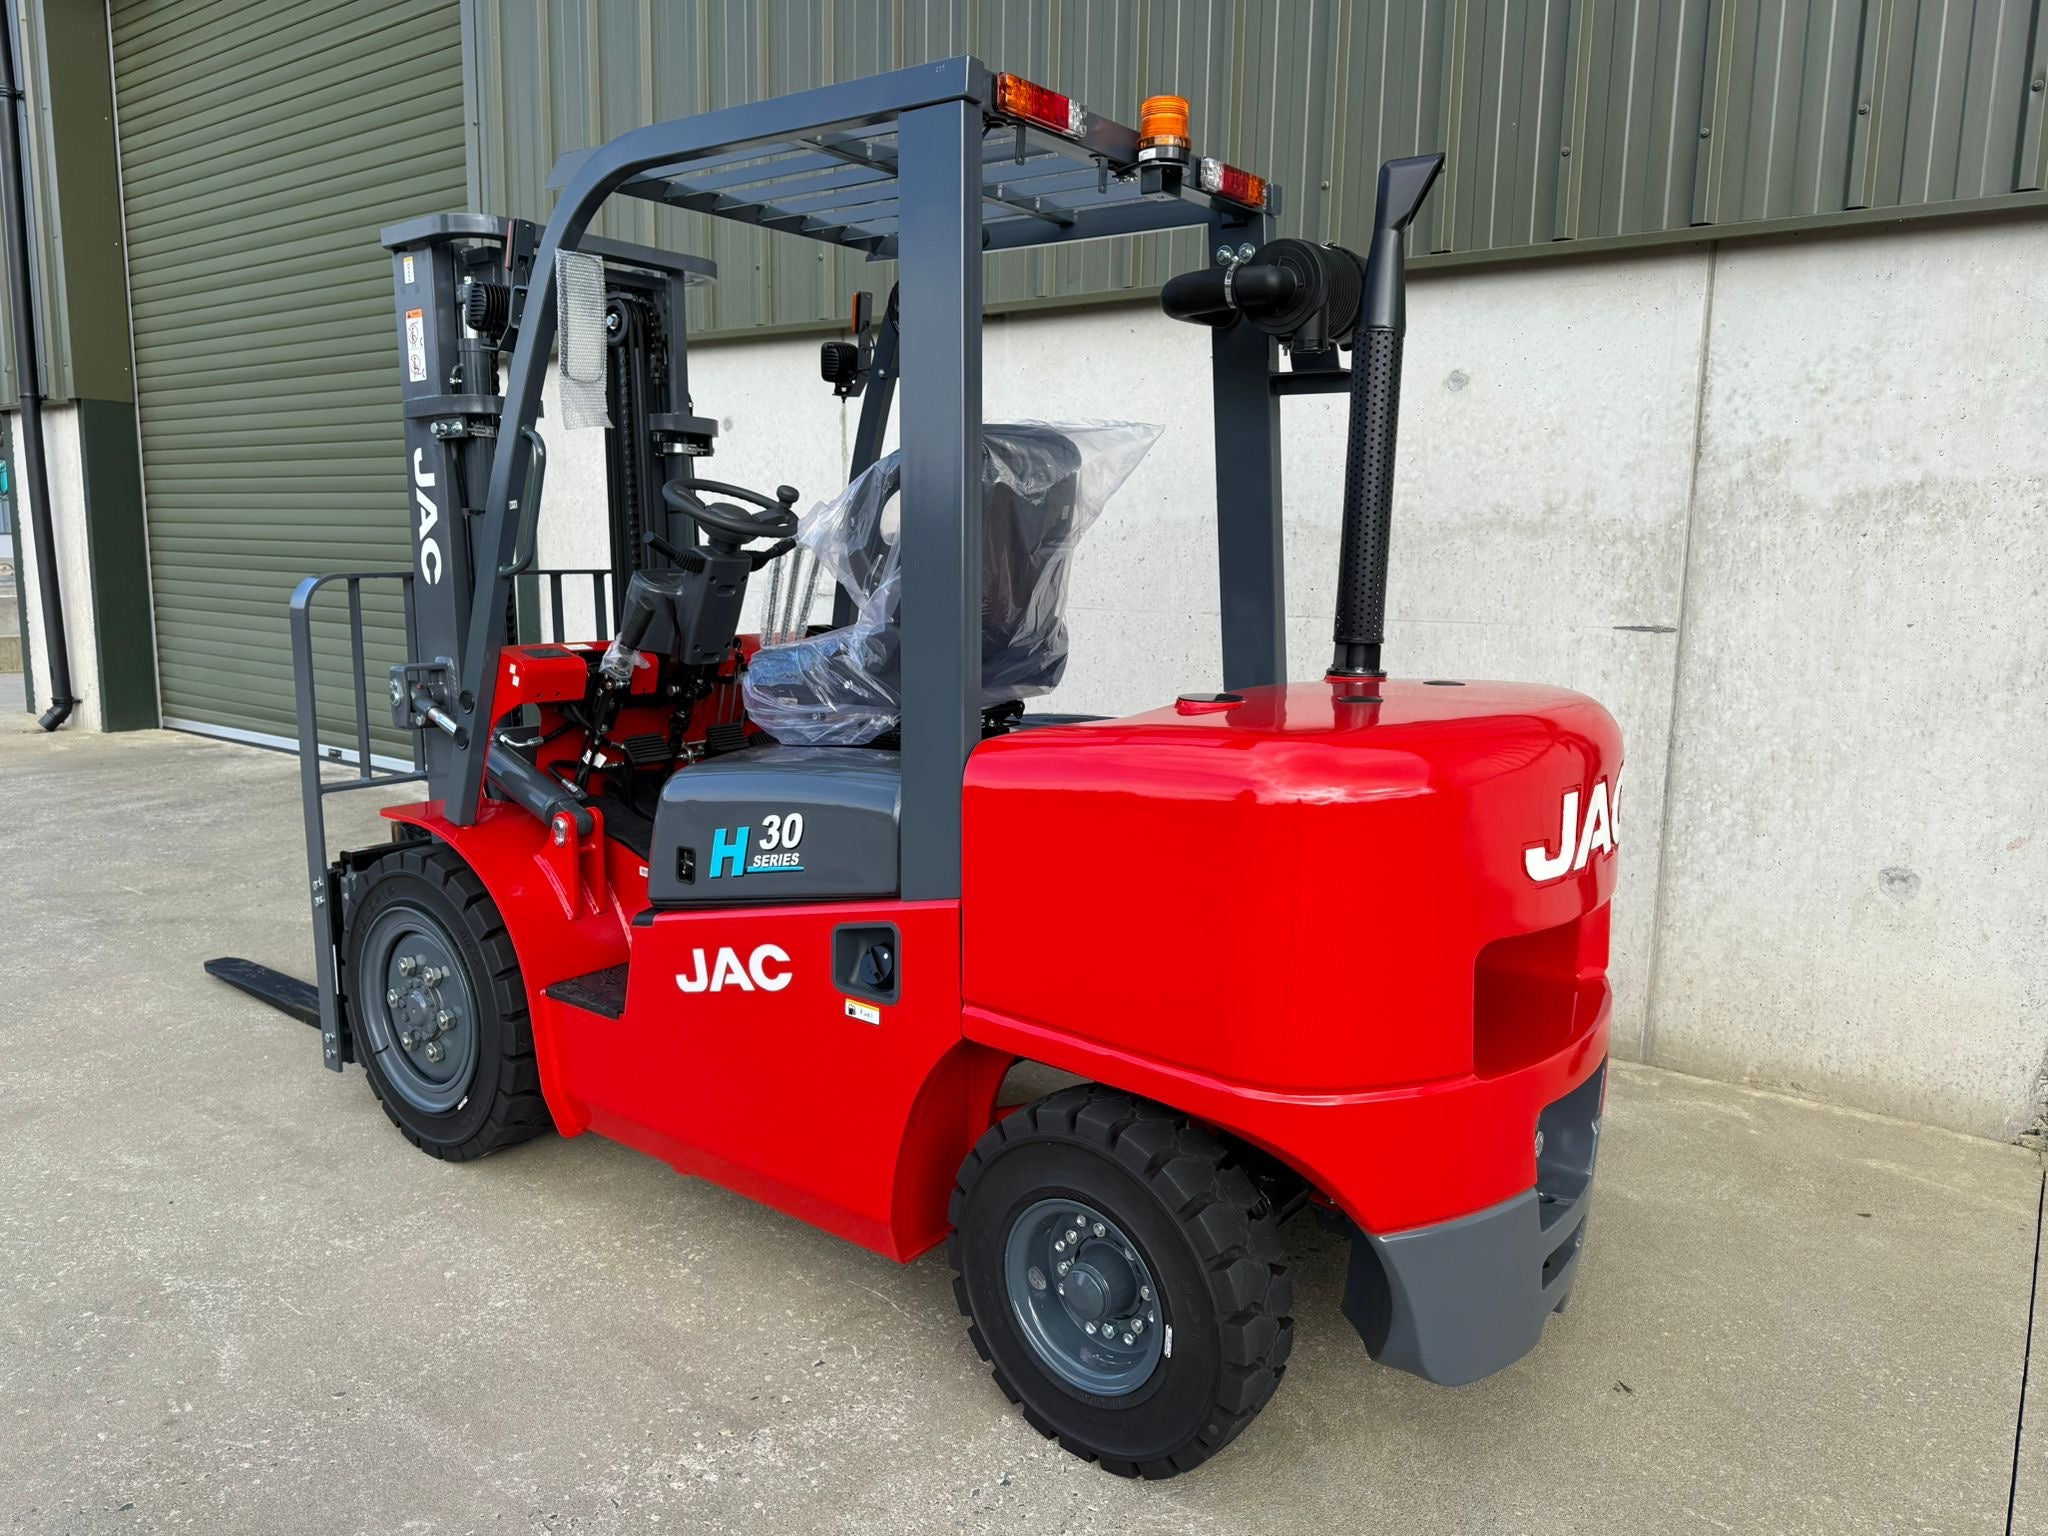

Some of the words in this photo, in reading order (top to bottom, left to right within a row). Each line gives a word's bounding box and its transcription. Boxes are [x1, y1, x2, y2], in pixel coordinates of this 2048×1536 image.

[413, 447, 442, 585] JAC
[709, 826, 751, 878] H
[759, 812, 804, 850] 30
[752, 852, 800, 868] SERIES
[675, 943, 793, 993] JAC
